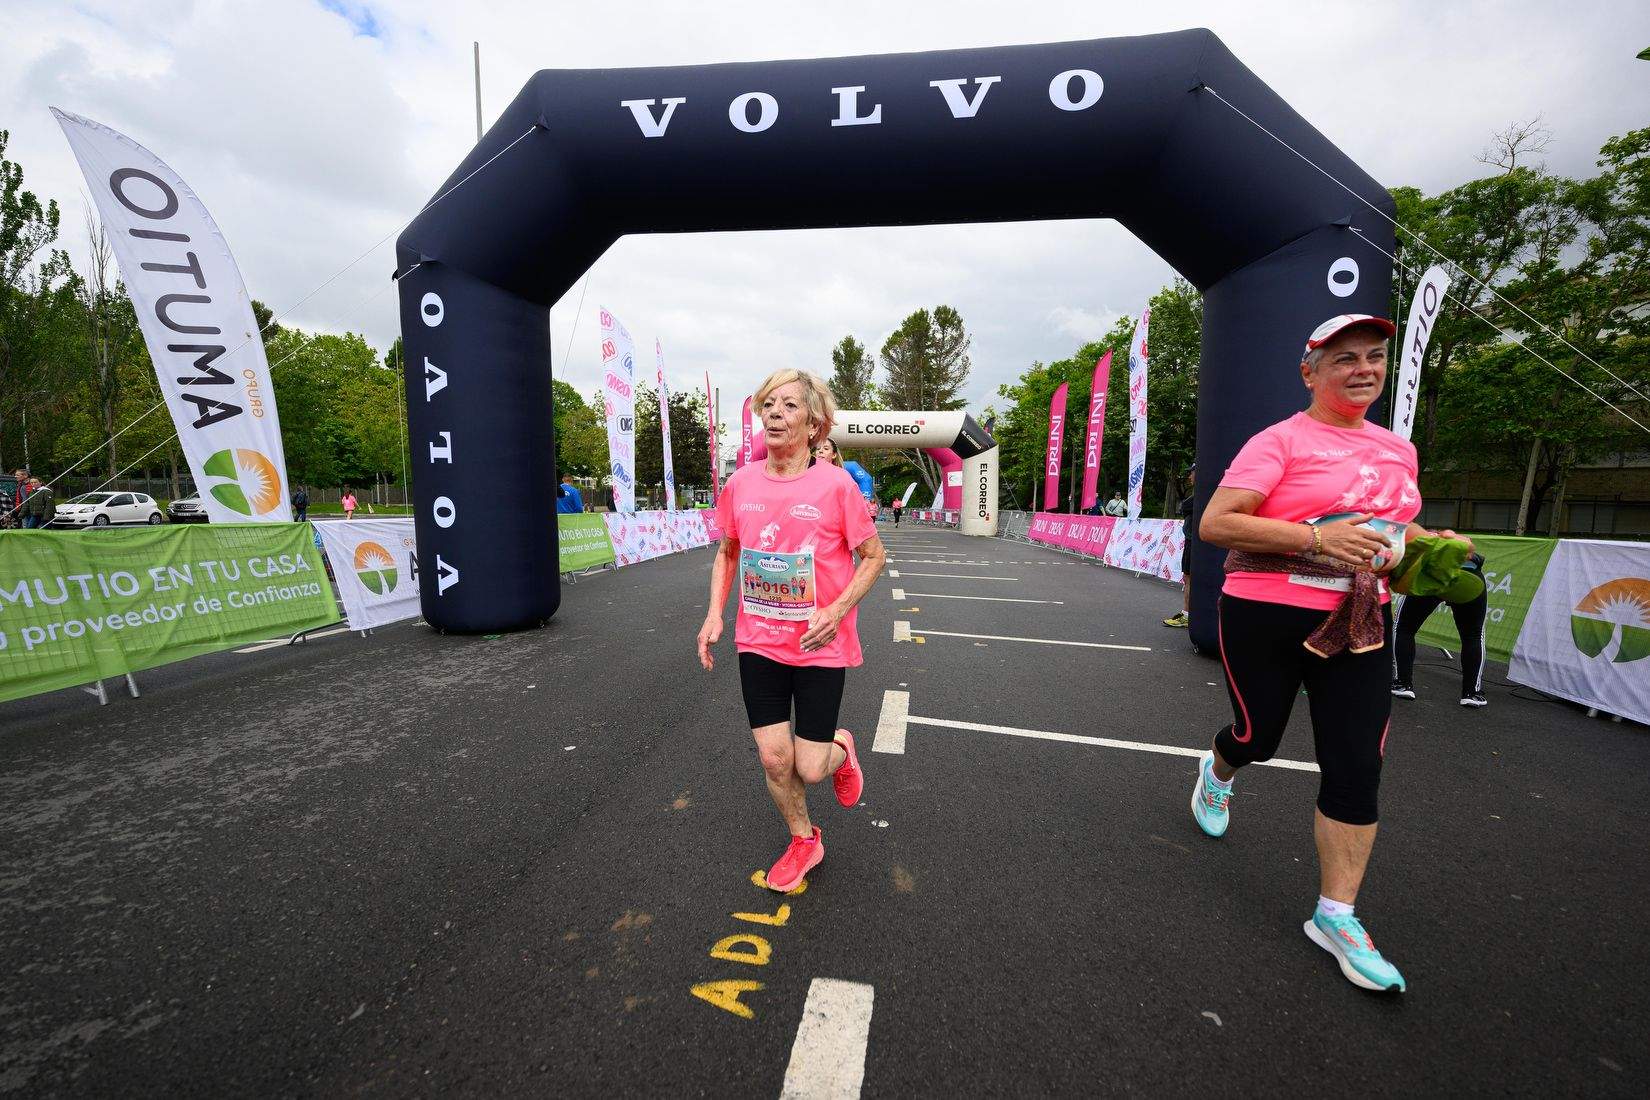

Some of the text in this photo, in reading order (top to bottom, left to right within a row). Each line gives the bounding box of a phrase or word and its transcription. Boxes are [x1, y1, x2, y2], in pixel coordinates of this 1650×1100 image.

[621, 68, 1105, 138] VOLVO
[420, 292, 460, 596] VOLVO
[743, 424, 752, 465] RUNI
[848, 424, 921, 435] EL CORREO
[1048, 415, 1062, 476] DRUNI
[978, 463, 988, 518] EL CORREO
[148, 564, 194, 592] EN
[199, 559, 241, 584] TU
[247, 553, 312, 578] CASA
[21, 603, 186, 650] proveedor
[193, 595, 223, 615] de
[227, 582, 321, 609] Confianza
